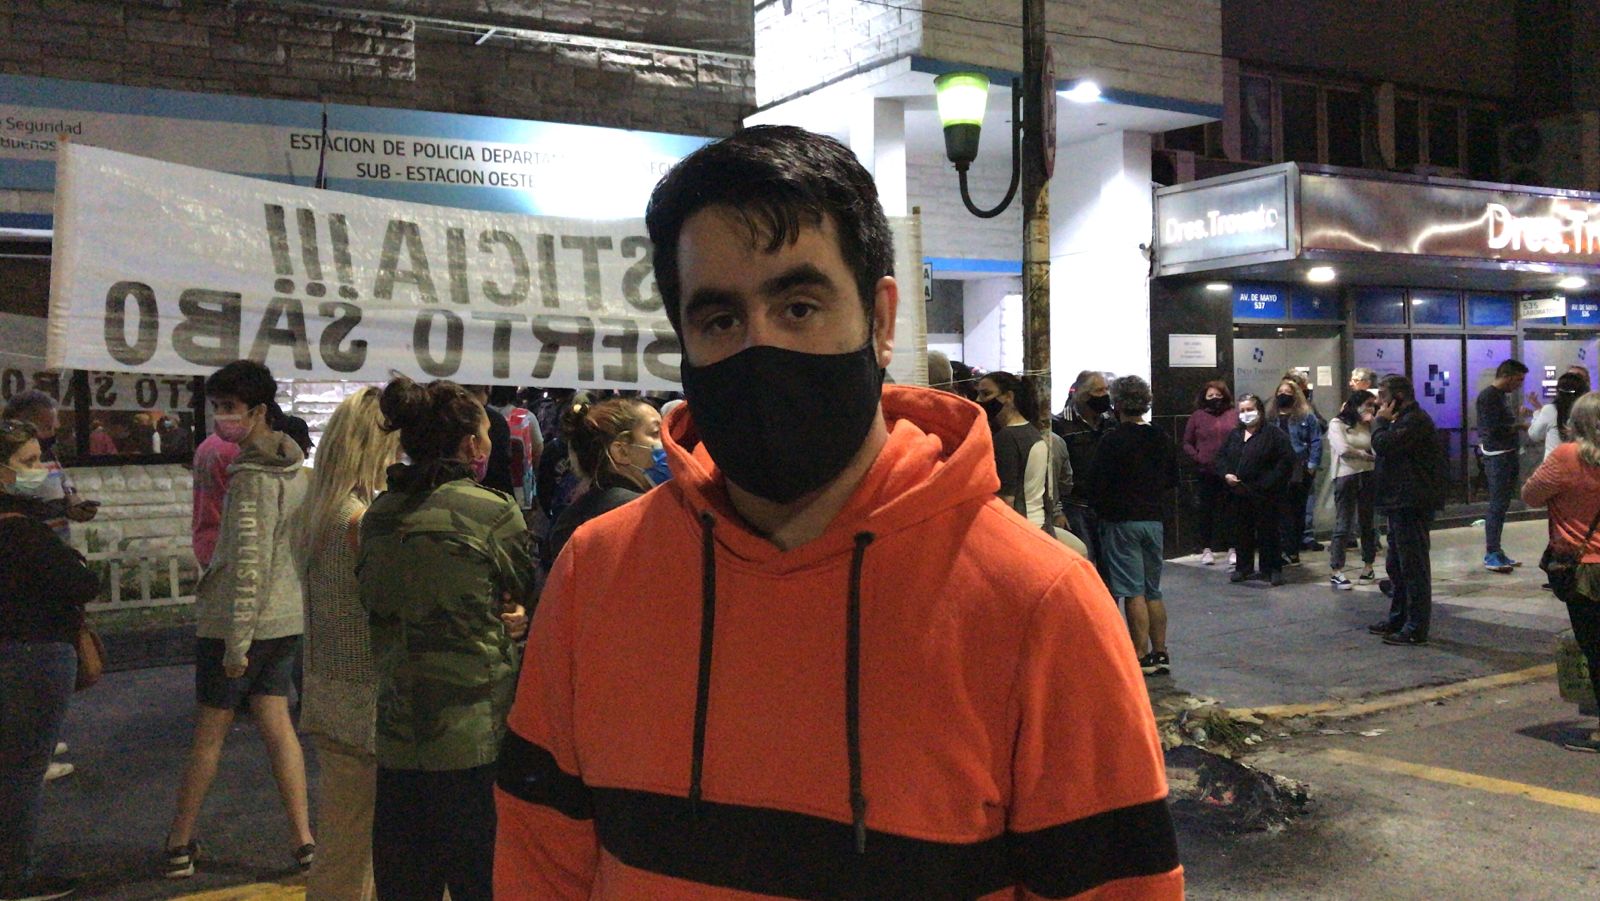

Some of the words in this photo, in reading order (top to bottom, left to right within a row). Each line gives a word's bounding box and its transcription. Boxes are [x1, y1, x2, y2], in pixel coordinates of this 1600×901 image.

[6, 116, 82, 135] Seguridad
[289, 133, 375, 154] ESTACION
[383, 140, 406, 156] DE
[413, 142, 475, 161] POLICIA
[356, 162, 391, 179] SUB
[406, 165, 484, 185] ESTACION
[488, 171, 535, 188] OESTE
[1259, 294, 1278, 303] MAYO
[233, 500, 258, 622] HOLLISTER
